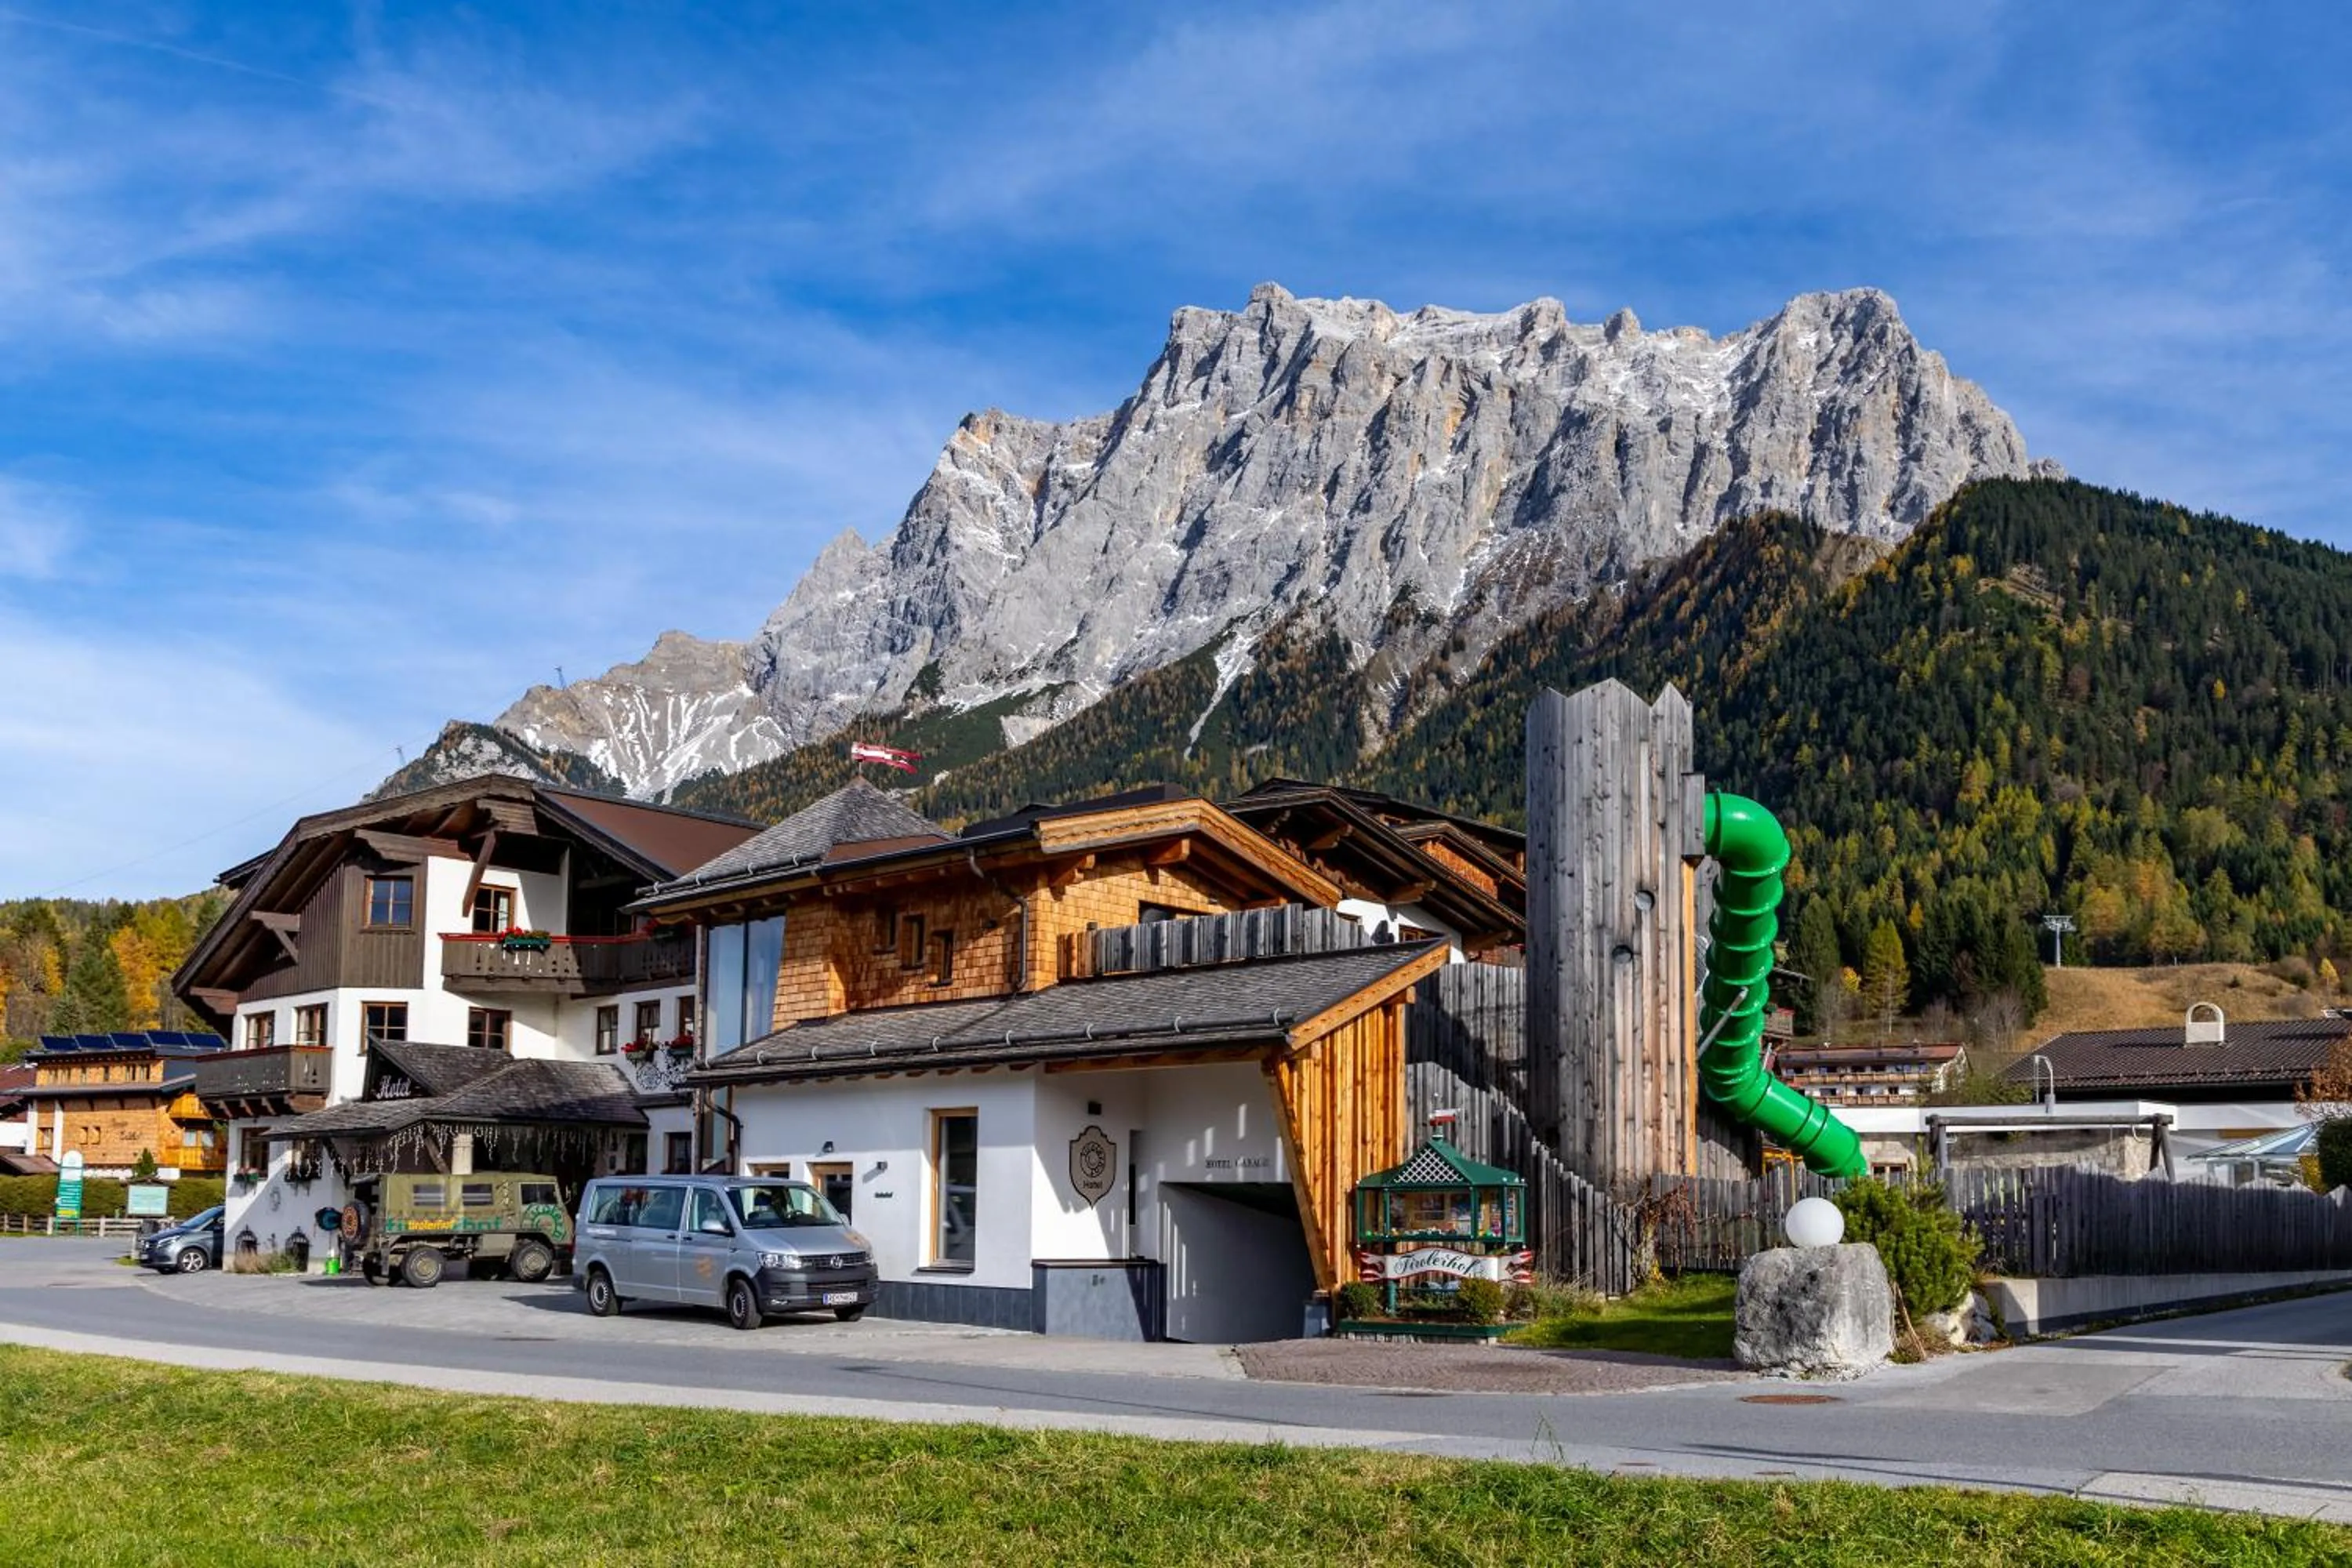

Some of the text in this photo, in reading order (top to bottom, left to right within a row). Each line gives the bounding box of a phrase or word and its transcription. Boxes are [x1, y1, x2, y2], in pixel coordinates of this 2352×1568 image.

[376, 1075, 412, 1099] Hotel
[1206, 1160, 1232, 1169] HOTEL
[1395, 1250, 1480, 1275] Tirolerhof
